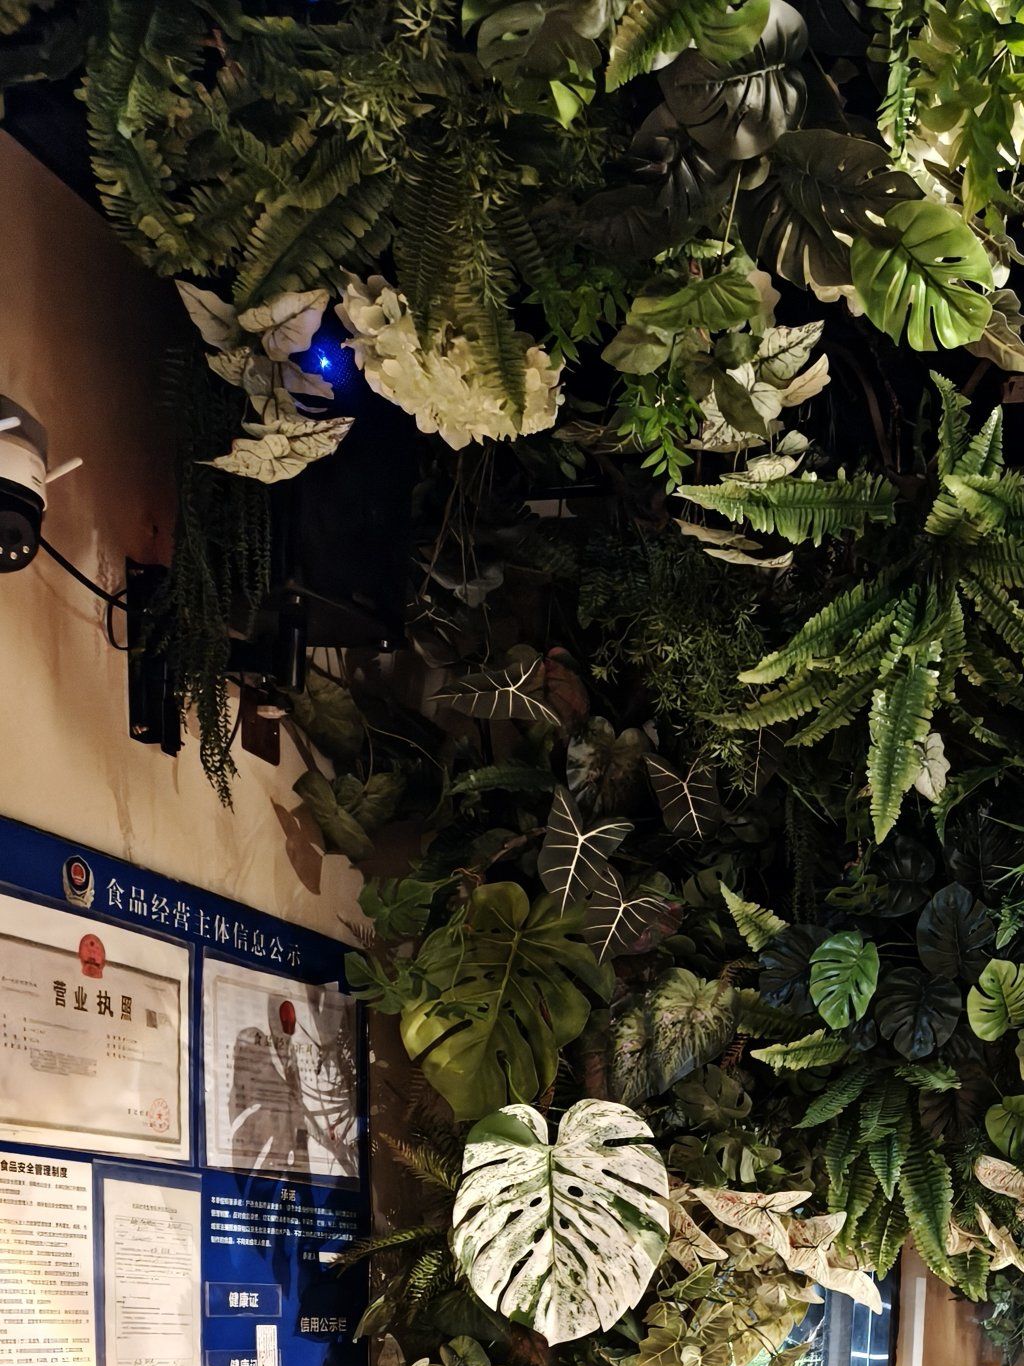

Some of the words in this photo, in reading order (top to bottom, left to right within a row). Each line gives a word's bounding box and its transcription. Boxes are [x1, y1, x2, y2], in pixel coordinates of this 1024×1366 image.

[106, 878, 302, 967] 食品经营主体信息公示
[53, 980, 133, 1021] 营业执照
[0, 1159, 68, 1178] 食品安全管理制度
[229, 1292, 259, 1308] 健康证
[300, 1318, 346, 1333] 信用公示栏
